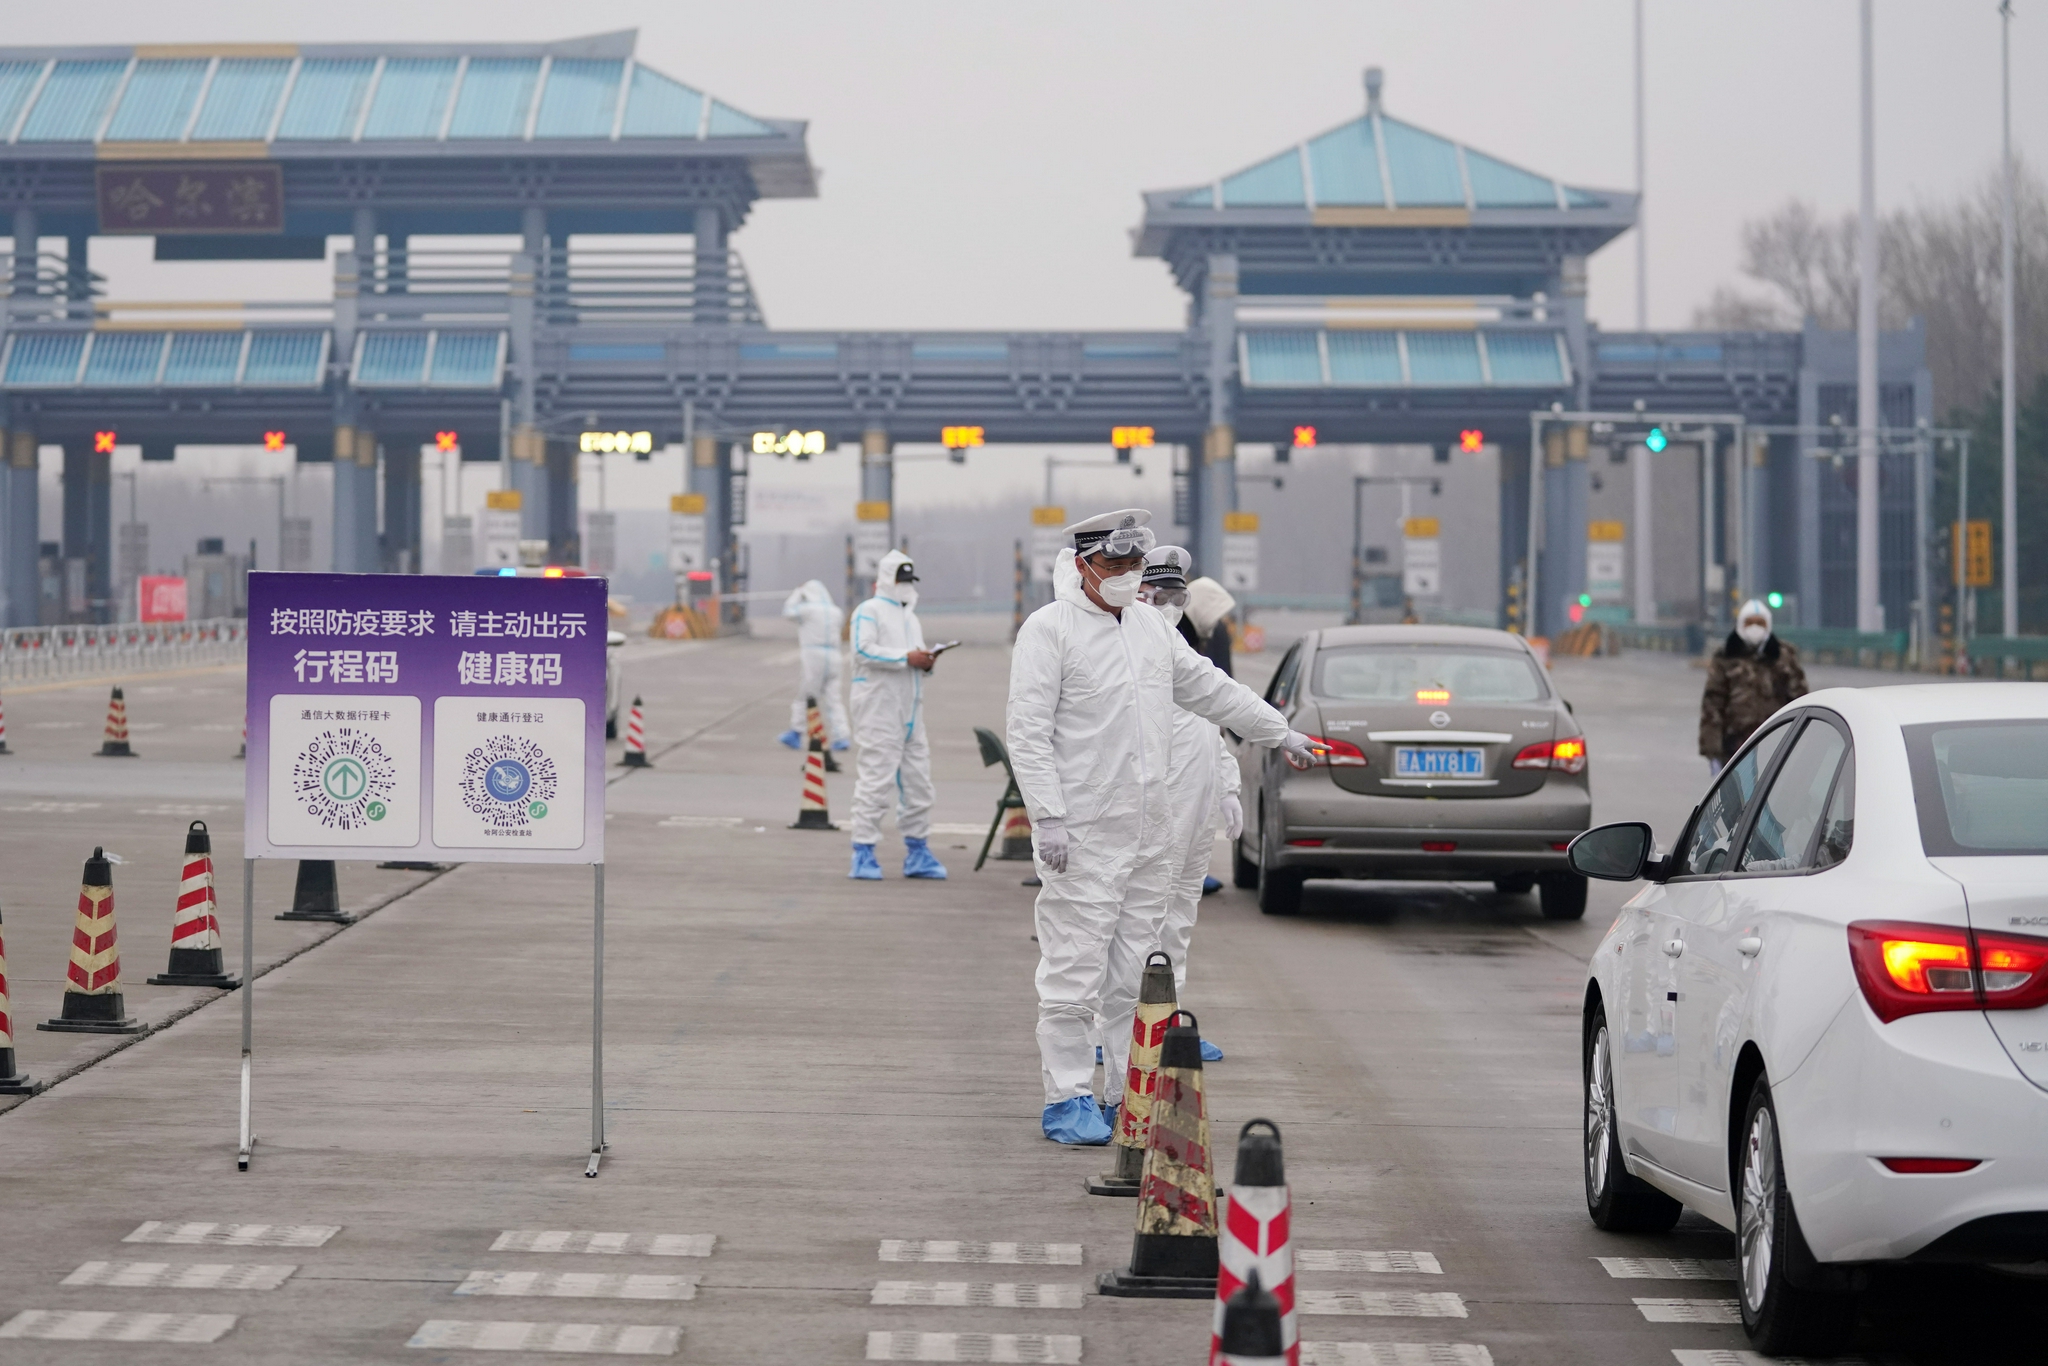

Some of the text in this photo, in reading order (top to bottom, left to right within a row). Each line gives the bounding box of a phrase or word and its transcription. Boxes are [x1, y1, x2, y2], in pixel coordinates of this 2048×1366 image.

[270, 608, 587, 639] 按照防疫要求 请主动出示
[293, 649, 399, 684] 行程码
[457, 651, 563, 686] 健康码
[301, 709, 391, 721] 通信大数据行程卡
[476, 712, 544, 723] 健康通行登记
